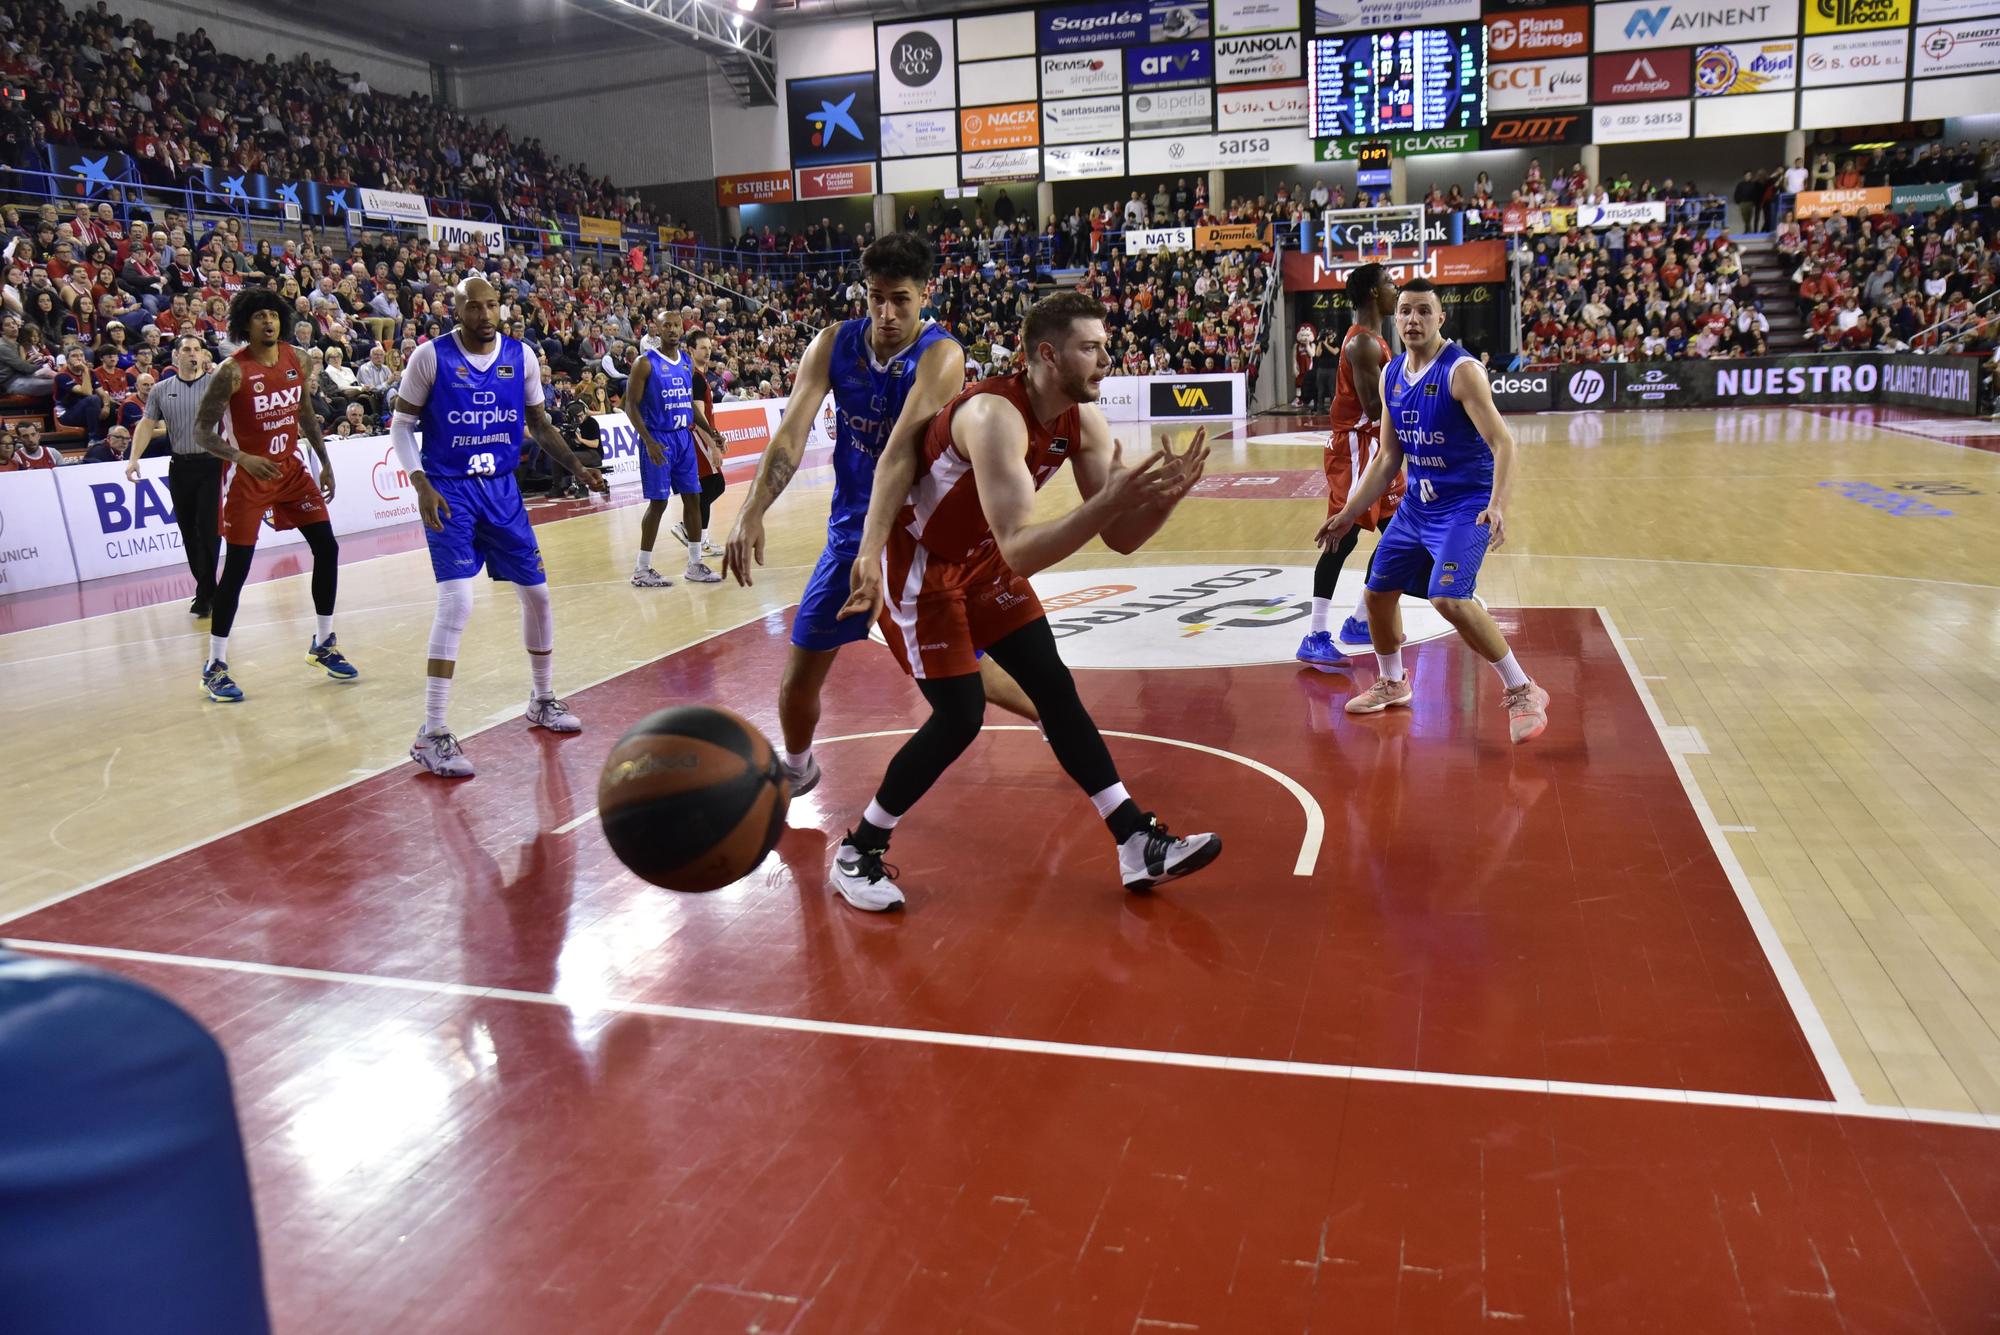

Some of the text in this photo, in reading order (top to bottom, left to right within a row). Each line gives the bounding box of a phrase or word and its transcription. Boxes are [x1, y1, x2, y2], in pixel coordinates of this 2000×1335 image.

[1051, 10, 1143, 31] Sagalés
[1519, 18, 1564, 32] Plana
[1671, 5, 1770, 30] AVINENT
[1058, 30, 1136, 45] www.sagales.com
[1218, 36, 1297, 55] JUANOLA
[1519, 31, 1583, 48] Fábrega
[901, 44, 933, 62] Ros
[1850, 55, 1881, 68] GOL
[1070, 71, 1119, 86] simplifica
[1488, 65, 1582, 94] GCT plus
[987, 109, 1036, 127] NACEX
[1061, 103, 1121, 117] santasusana
[1645, 112, 1683, 125] sarsa
[1220, 138, 1270, 154] sarsa
[1404, 134, 1469, 151] CLARET
[737, 179, 790, 194] ESTRELLA
[1820, 190, 1867, 203] KIBUC
[1607, 205, 1652, 219] masats
[1346, 220, 1448, 247] CaixaBank
[1490, 375, 1548, 395] desa
[1569, 369, 1605, 405] hp
[1627, 383, 1681, 392] CONTROL
[1717, 363, 1970, 400] NUESTRO PLANETA CUENTA
[254, 385, 302, 413] BAXI
[263, 415, 295, 431] MANRESA
[447, 406, 518, 430] carplus
[673, 415, 687, 429] 24
[452, 432, 511, 448] FUENLABRADA
[749, 426, 768, 439] DAMM
[1396, 426, 1445, 450] carplus
[600, 424, 640, 460] BAX
[466, 452, 495, 477] 33
[89, 476, 178, 534] BAX
[374, 505, 410, 520] innovation
[0, 546, 38, 564] UNICH
[1050, 568, 1283, 639] CONTRO
